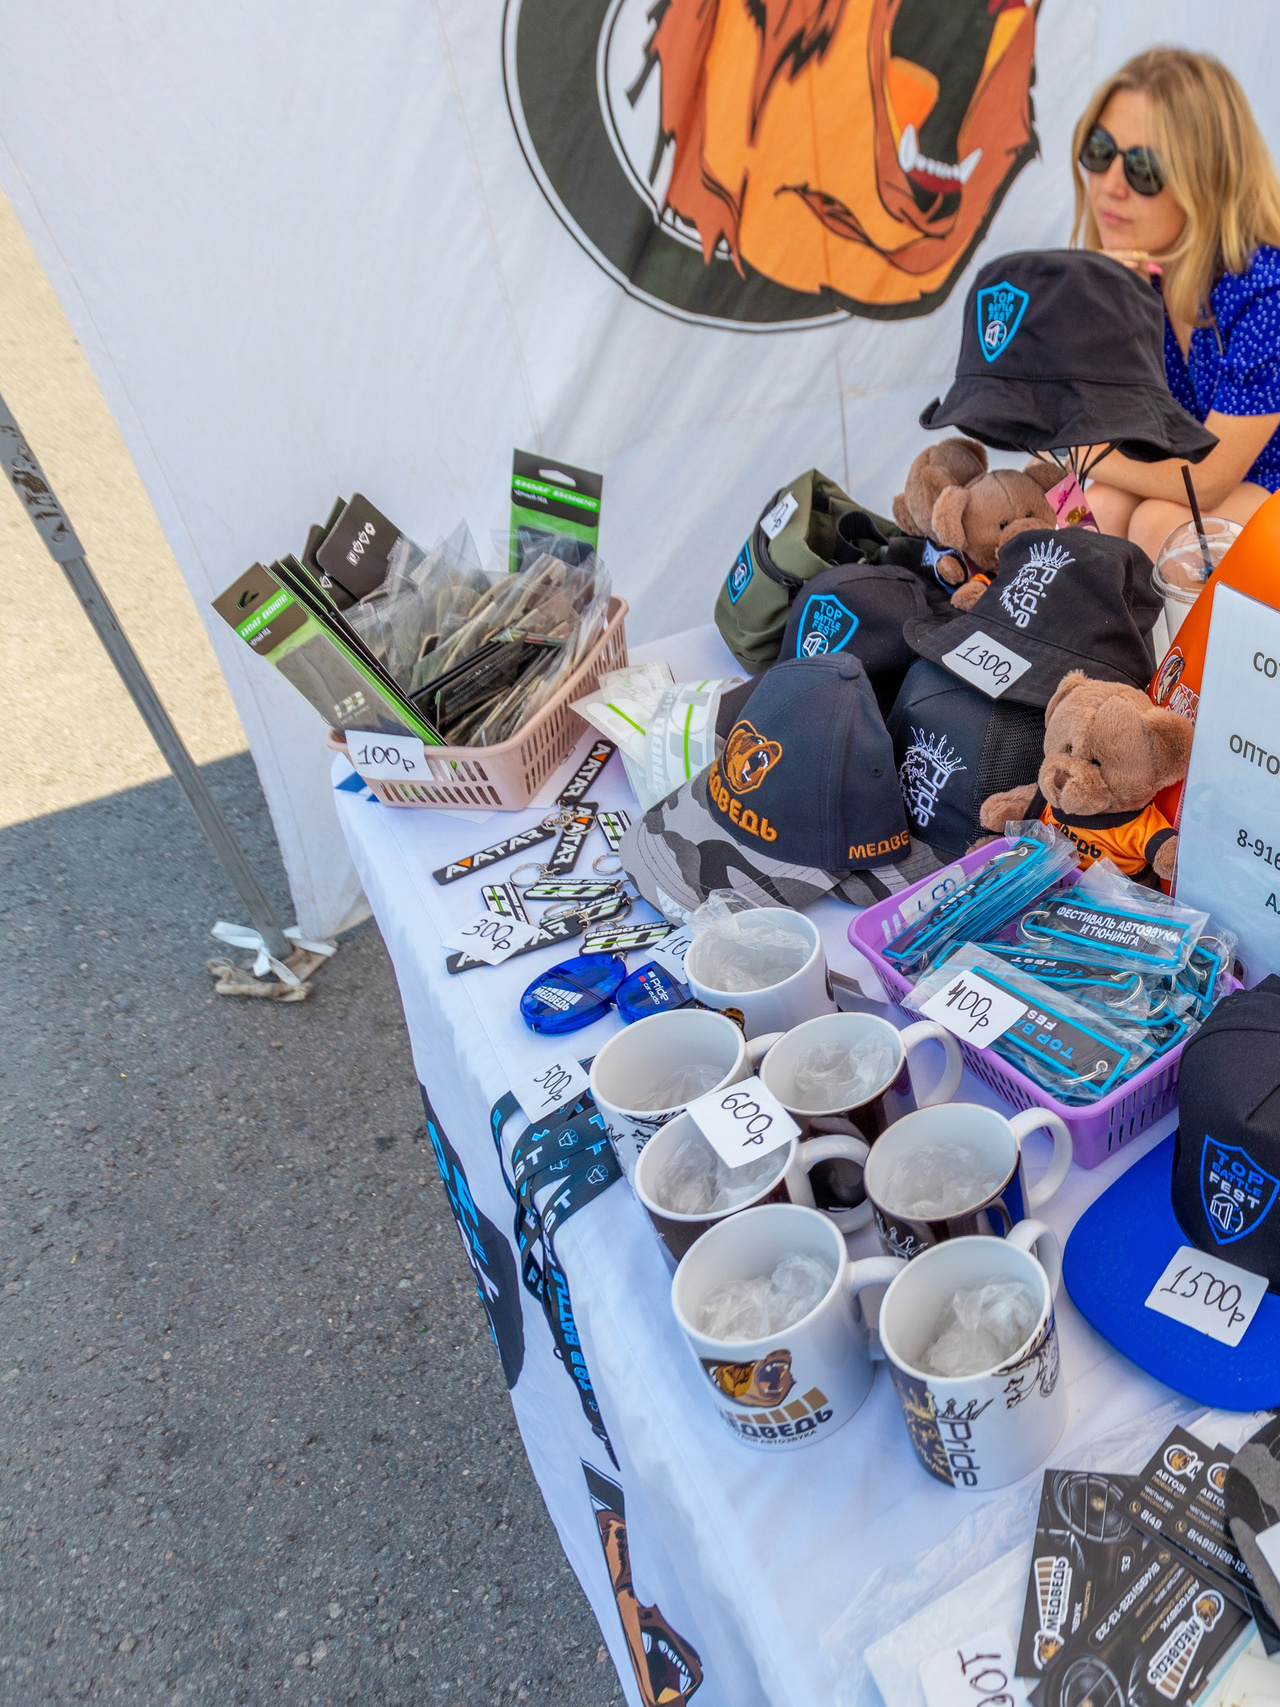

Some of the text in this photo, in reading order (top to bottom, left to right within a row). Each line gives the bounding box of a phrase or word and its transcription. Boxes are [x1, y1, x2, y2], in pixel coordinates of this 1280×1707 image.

[992, 291, 1015, 304] TOP
[988, 312, 1011, 322] FEST
[820, 600, 842, 619] TOP
[1015, 565, 1057, 630] Pride
[811, 620, 837, 638] FEST
[813, 610, 842, 631] BATTLE
[957, 644, 1012, 685] 1300р
[356, 744, 416, 773] 100р
[708, 756, 778, 842] ДВЕДЬ
[910, 763, 951, 828] Pride
[461, 918, 514, 951] 300р
[1056, 905, 1179, 943] ФЕСТИВАЛЬ АВТОЗВУКА
[1080, 924, 1140, 947] И ТЮНИНГА
[650, 977, 669, 1002] Pride
[1041, 966, 1084, 978] TOP
[532, 986, 570, 1012] МЕДВЕДЬ
[648, 990, 661, 1006] audio
[947, 979, 994, 1032] 400р
[1038, 1032, 1075, 1060] TOP
[533, 1063, 573, 1108] 500р
[722, 1092, 774, 1145] 600р
[1211, 1162, 1262, 1198] BATTLE
[1216, 1150, 1264, 1185] TOP
[1209, 1171, 1260, 1209] FEST
[556, 1268, 583, 1350] BATTLE
[1160, 1266, 1245, 1327] 1500р
[570, 1350, 593, 1392] TOP
[939, 1418, 980, 1487] Pride
[1200, 1487, 1226, 1509] АВТО
[1047, 1560, 1066, 1631] МЕДВЕДЬ
[1160, 1579, 1200, 1632] АВТОЗВУК
[1150, 1619, 1201, 1681] МЕДВЕДЬ
